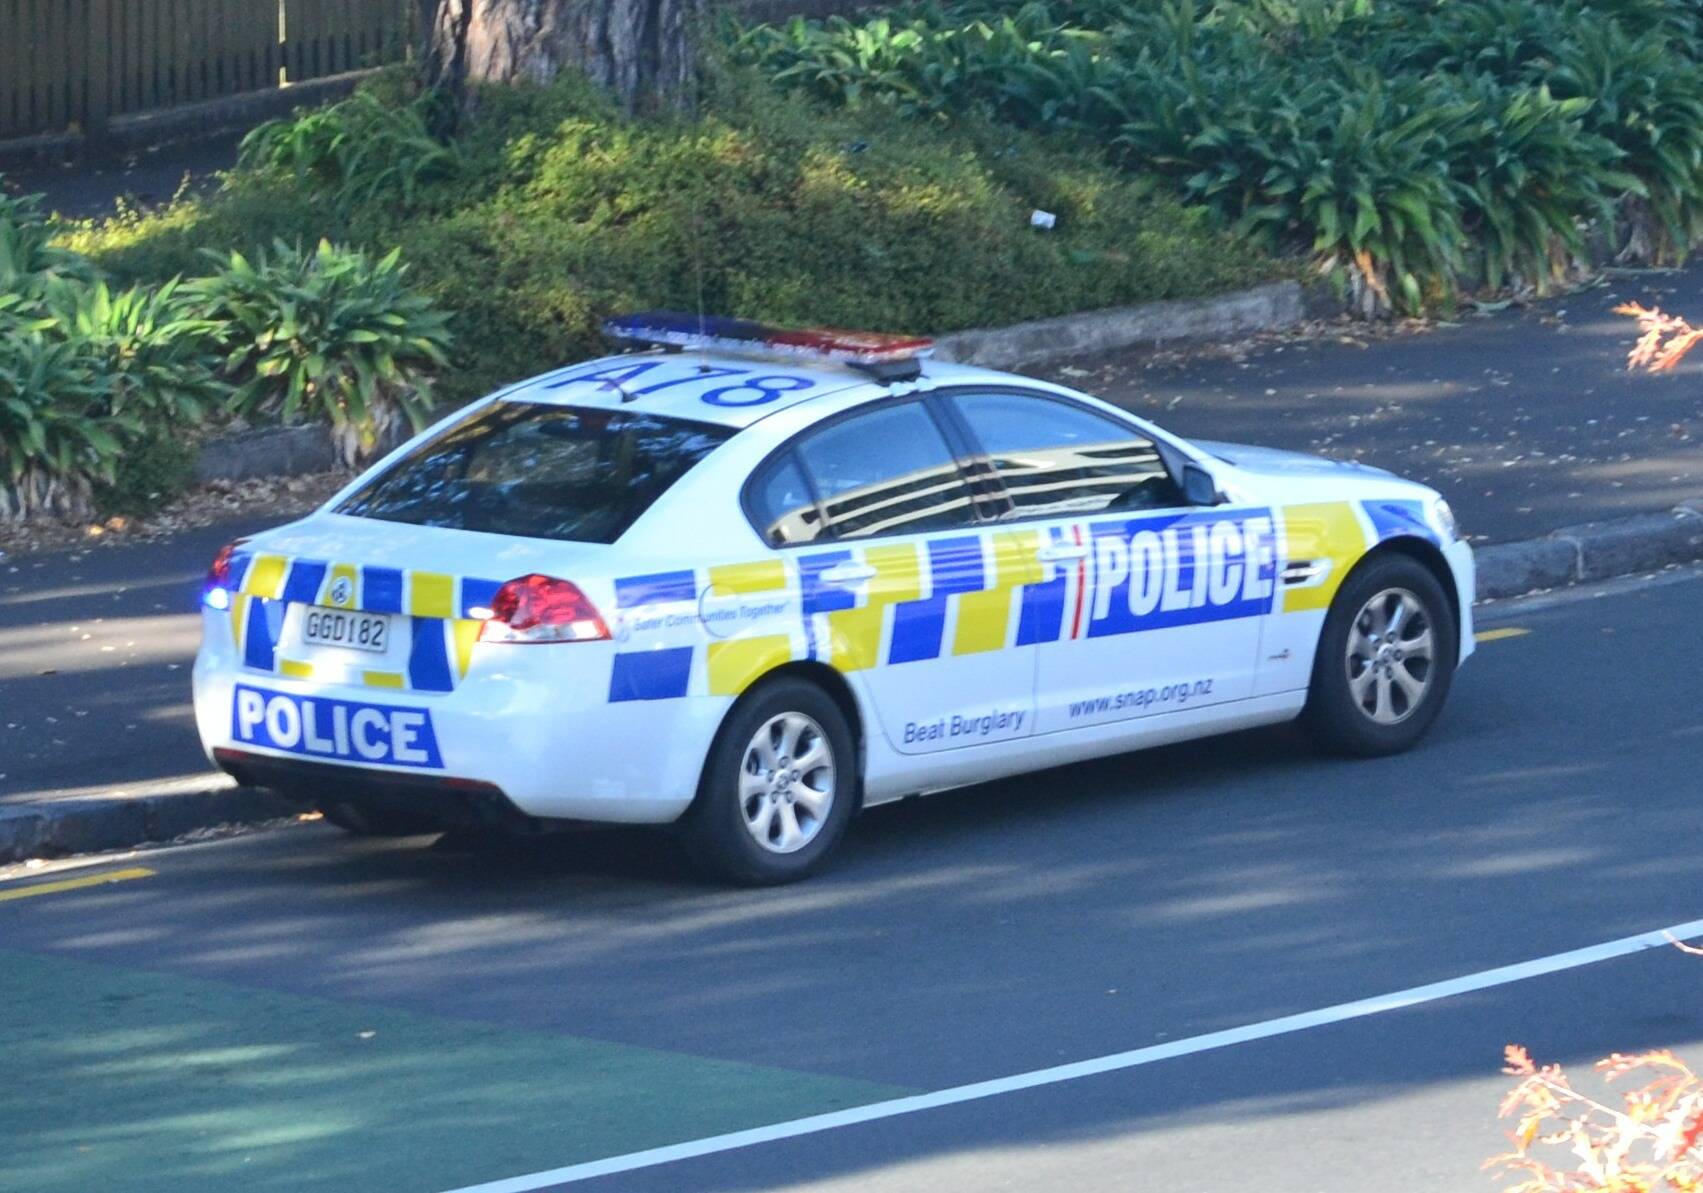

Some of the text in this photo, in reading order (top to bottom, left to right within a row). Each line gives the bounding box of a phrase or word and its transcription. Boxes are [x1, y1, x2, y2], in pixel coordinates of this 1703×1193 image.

[1091, 515, 1275, 621] POLICE
[307, 612, 387, 647] GGD182
[1068, 677, 1214, 718] www.snap.org.nz
[237, 688, 430, 764] POLICE
[903, 709, 1027, 744] Beat Burglary
